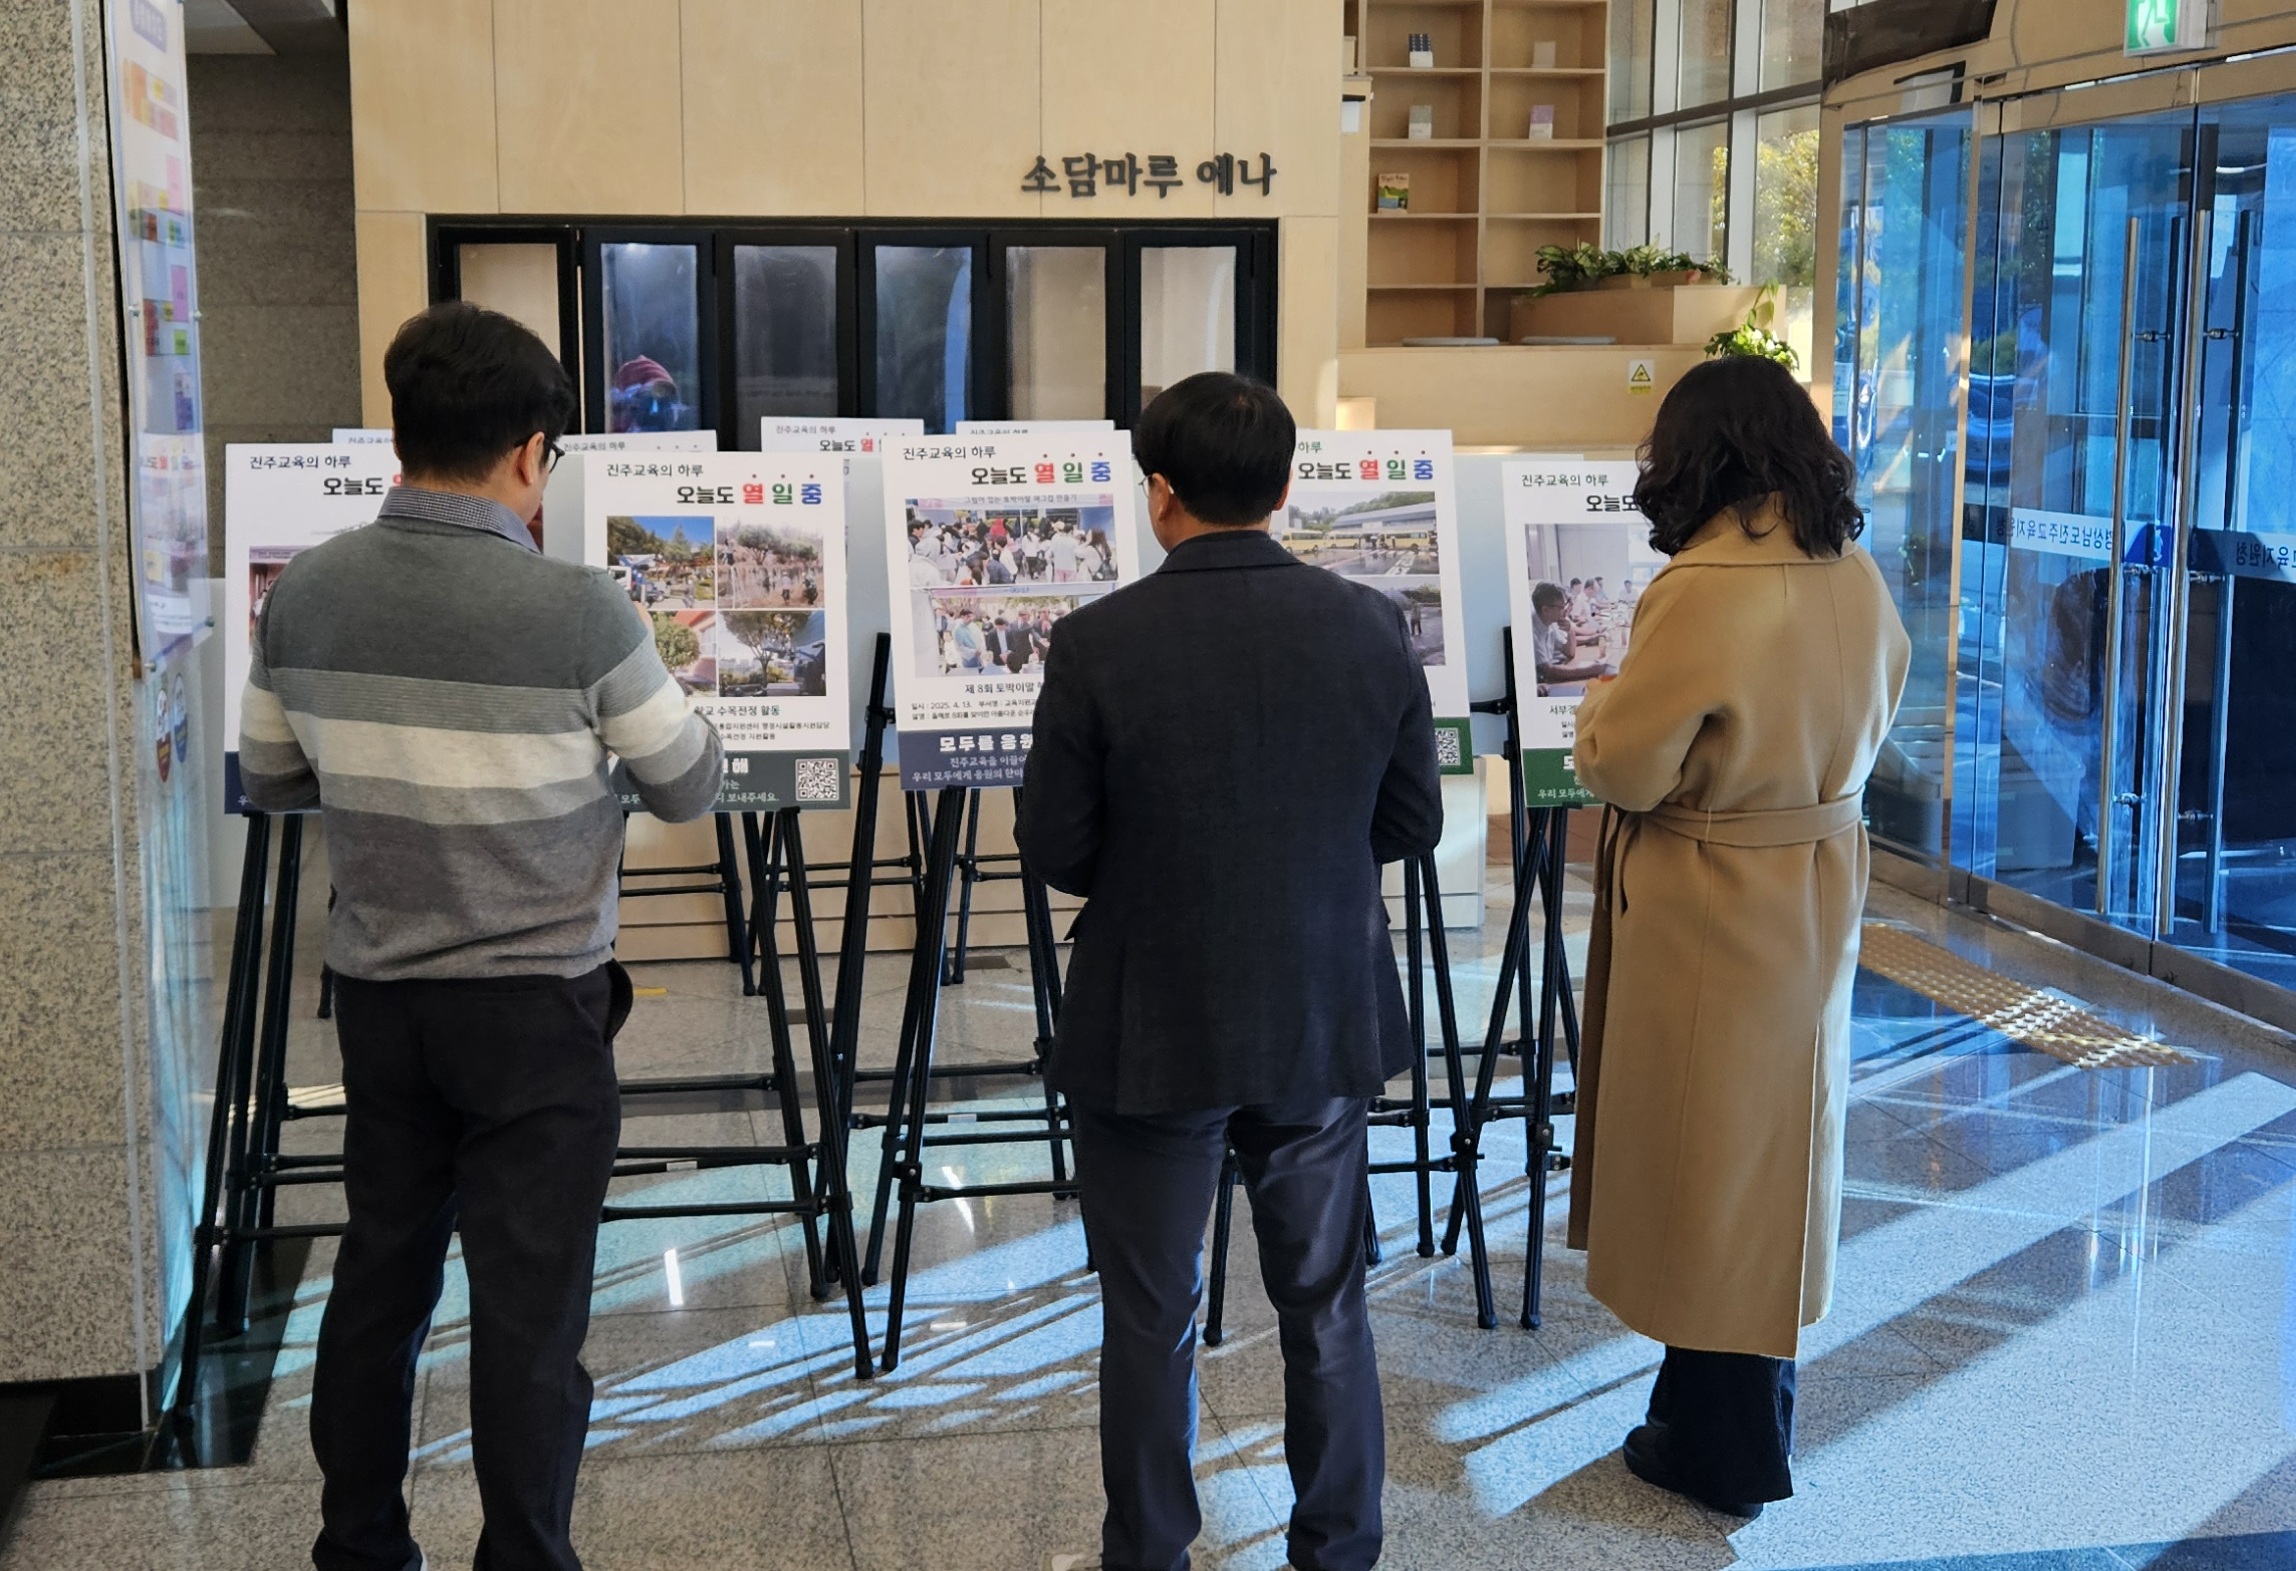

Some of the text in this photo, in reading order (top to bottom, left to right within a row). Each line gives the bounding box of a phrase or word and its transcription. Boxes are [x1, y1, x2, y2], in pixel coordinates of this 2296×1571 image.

[1021, 152, 1184, 199] 소담마루
[819, 439, 856, 452] 오늘도
[902, 446, 996, 460] 진주교육의 하루
[1298, 441, 1322, 454] 하루
[250, 455, 351, 470] 진주교육의 하루
[1298, 459, 1434, 480] 오늘도 열 일 중
[606, 463, 704, 478] 진주교육의 하루
[971, 461, 1111, 485] 오늘도 열 일 중
[323, 476, 384, 496] 오늘도
[1521, 474, 1609, 487] 진주교육의 하루
[676, 482, 822, 505] 오늘도 열 일 중
[965, 683, 975, 694] 제
[977, 683, 993, 694] 8회
[996, 681, 1035, 693] 토박이말
[939, 735, 995, 752] 모두를
[949, 755, 998, 768] 진주교육을
[911, 770, 932, 783] 우리
[933, 769, 972, 782] 모두에게
[973, 768, 1003, 781] 응원의
[728, 791, 781, 803] 보내주세요.
[1537, 787, 1556, 799] 우리
